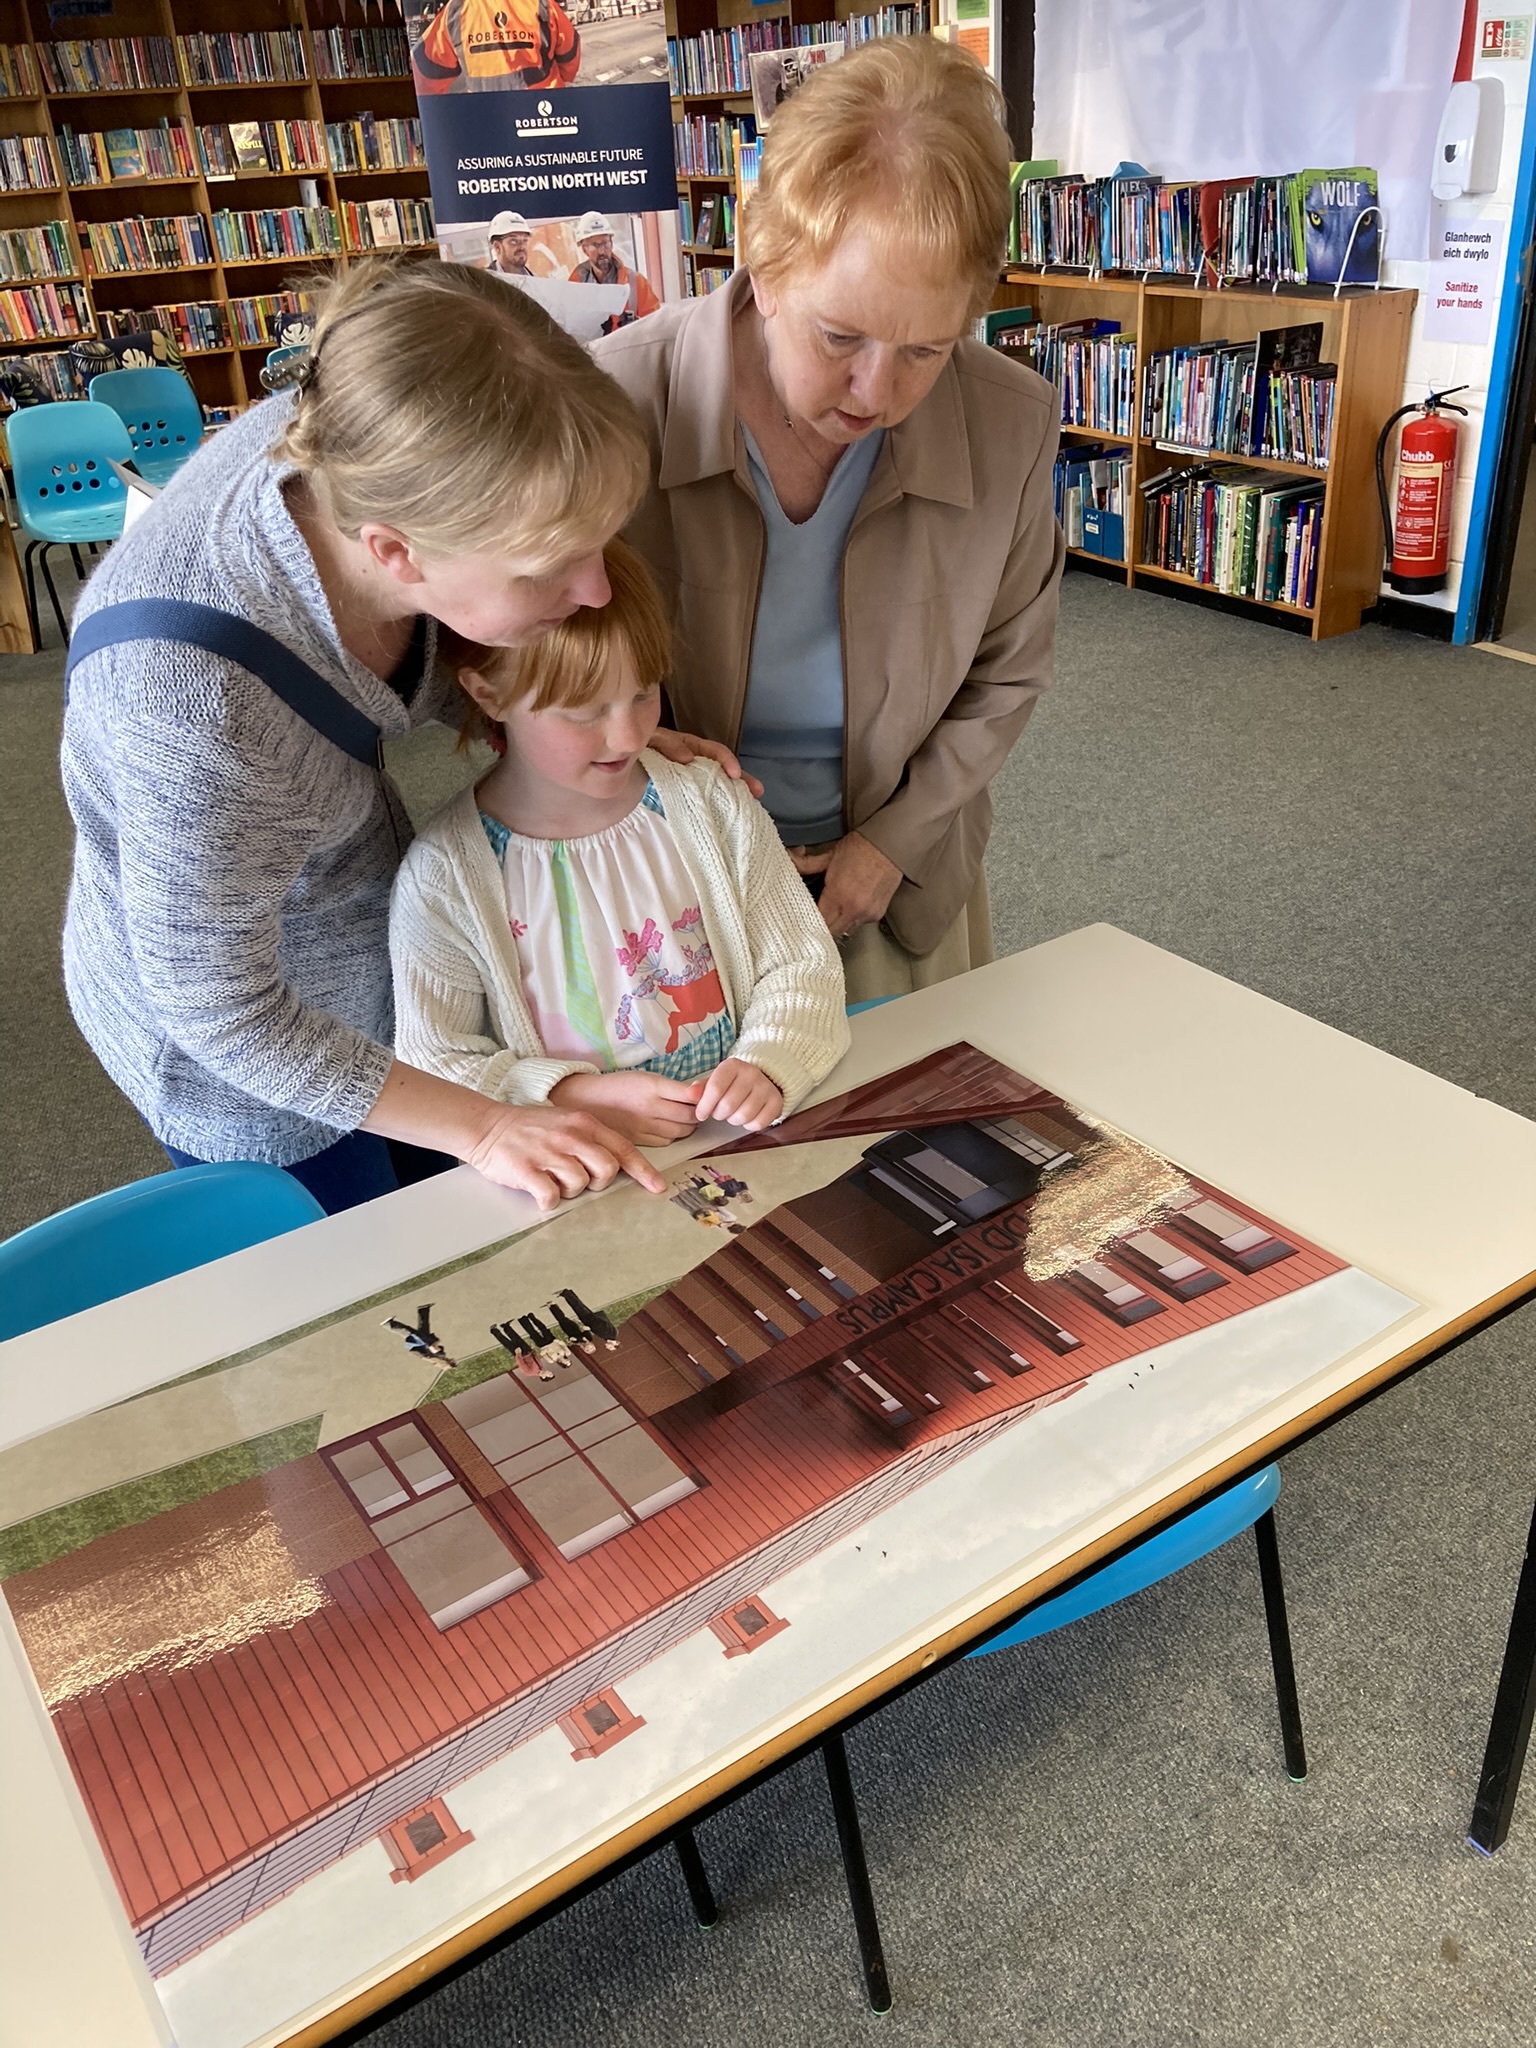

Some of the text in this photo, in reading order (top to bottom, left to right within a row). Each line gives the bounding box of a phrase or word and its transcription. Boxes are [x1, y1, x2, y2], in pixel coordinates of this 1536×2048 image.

[468, 30, 534, 44] ROBERTSON
[515, 116, 578, 128] ROBERTSON
[457, 148, 644, 171] ASSURING A SUSTAINABLE FUTURE
[457, 169, 648, 195] ROBERTSON NORTH WEST
[1120, 180, 1141, 195] ALEX
[1320, 180, 1361, 207] WOLF
[1445, 231, 1492, 244] Glanhewch
[1443, 247, 1489, 261] eich dwylo
[1445, 281, 1478, 293] Sanitize
[1437, 297, 1483, 309] your hands
[1401, 449, 1435, 462] Chubb
[931, 1241, 992, 1278] ISA
[836, 1268, 944, 1336] CAMPUS
